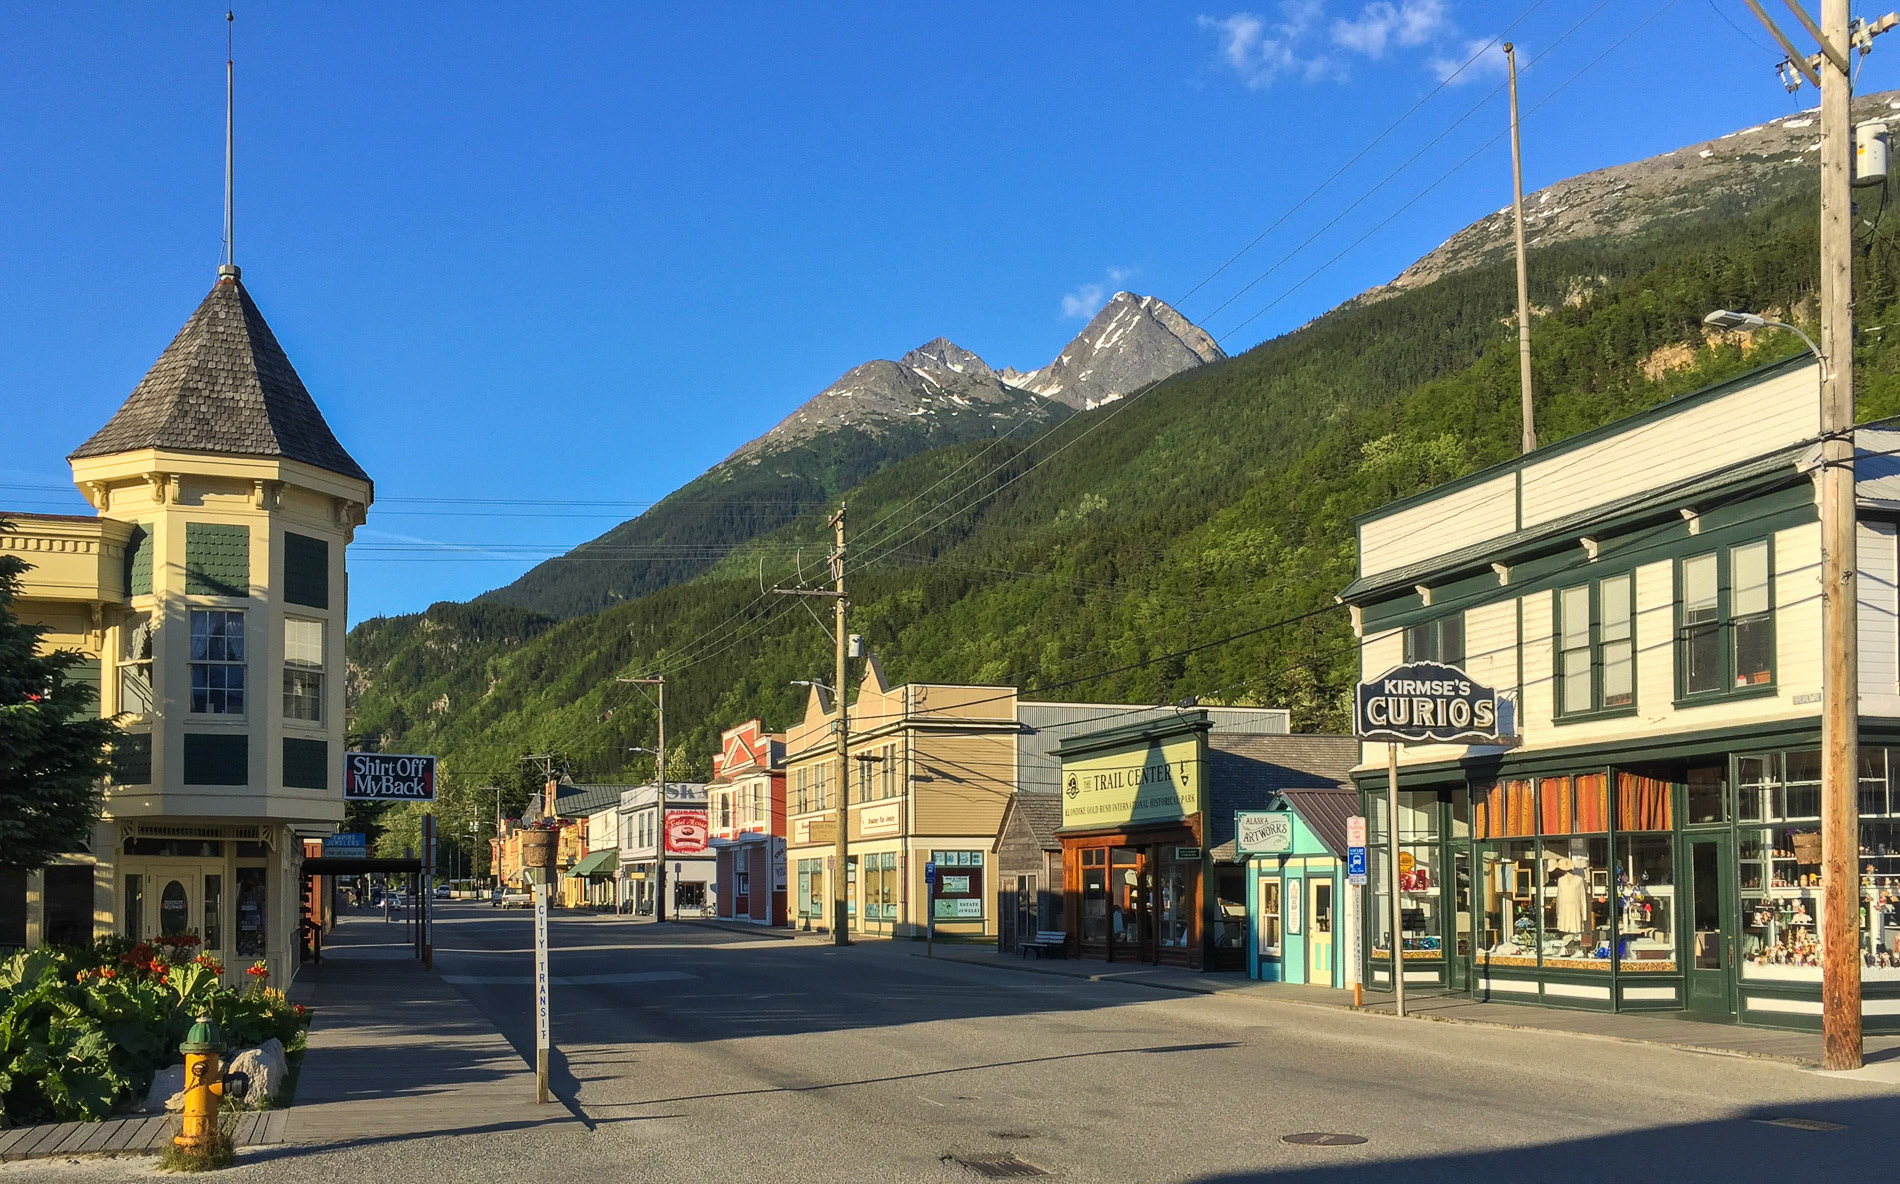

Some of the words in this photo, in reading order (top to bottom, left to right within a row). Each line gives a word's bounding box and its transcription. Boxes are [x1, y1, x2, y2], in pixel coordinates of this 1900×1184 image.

[1384, 679, 1471, 696] KIRMSE'S
[1367, 696, 1494, 728] CURIOS
[353, 756, 396, 776] Shirt
[396, 758, 427, 777] Off
[1094, 771, 1124, 791] TRAIL
[1128, 763, 1174, 787] CENTER
[1065, 806, 1086, 817] KLONDIKE
[1087, 805, 1099, 814] GOLD
[1100, 803, 1112, 813] RUSH
[1112, 798, 1149, 811] INTERNATIONAL
[1150, 794, 1179, 807] HISTORICAL
[1181, 793, 1196, 804] PARK
[1243, 823, 1288, 843] ARTWORKS
[1245, 817, 1268, 825] ALASKA
[538, 905, 546, 949] CITY
[539, 961, 547, 1040] TRANSIT
